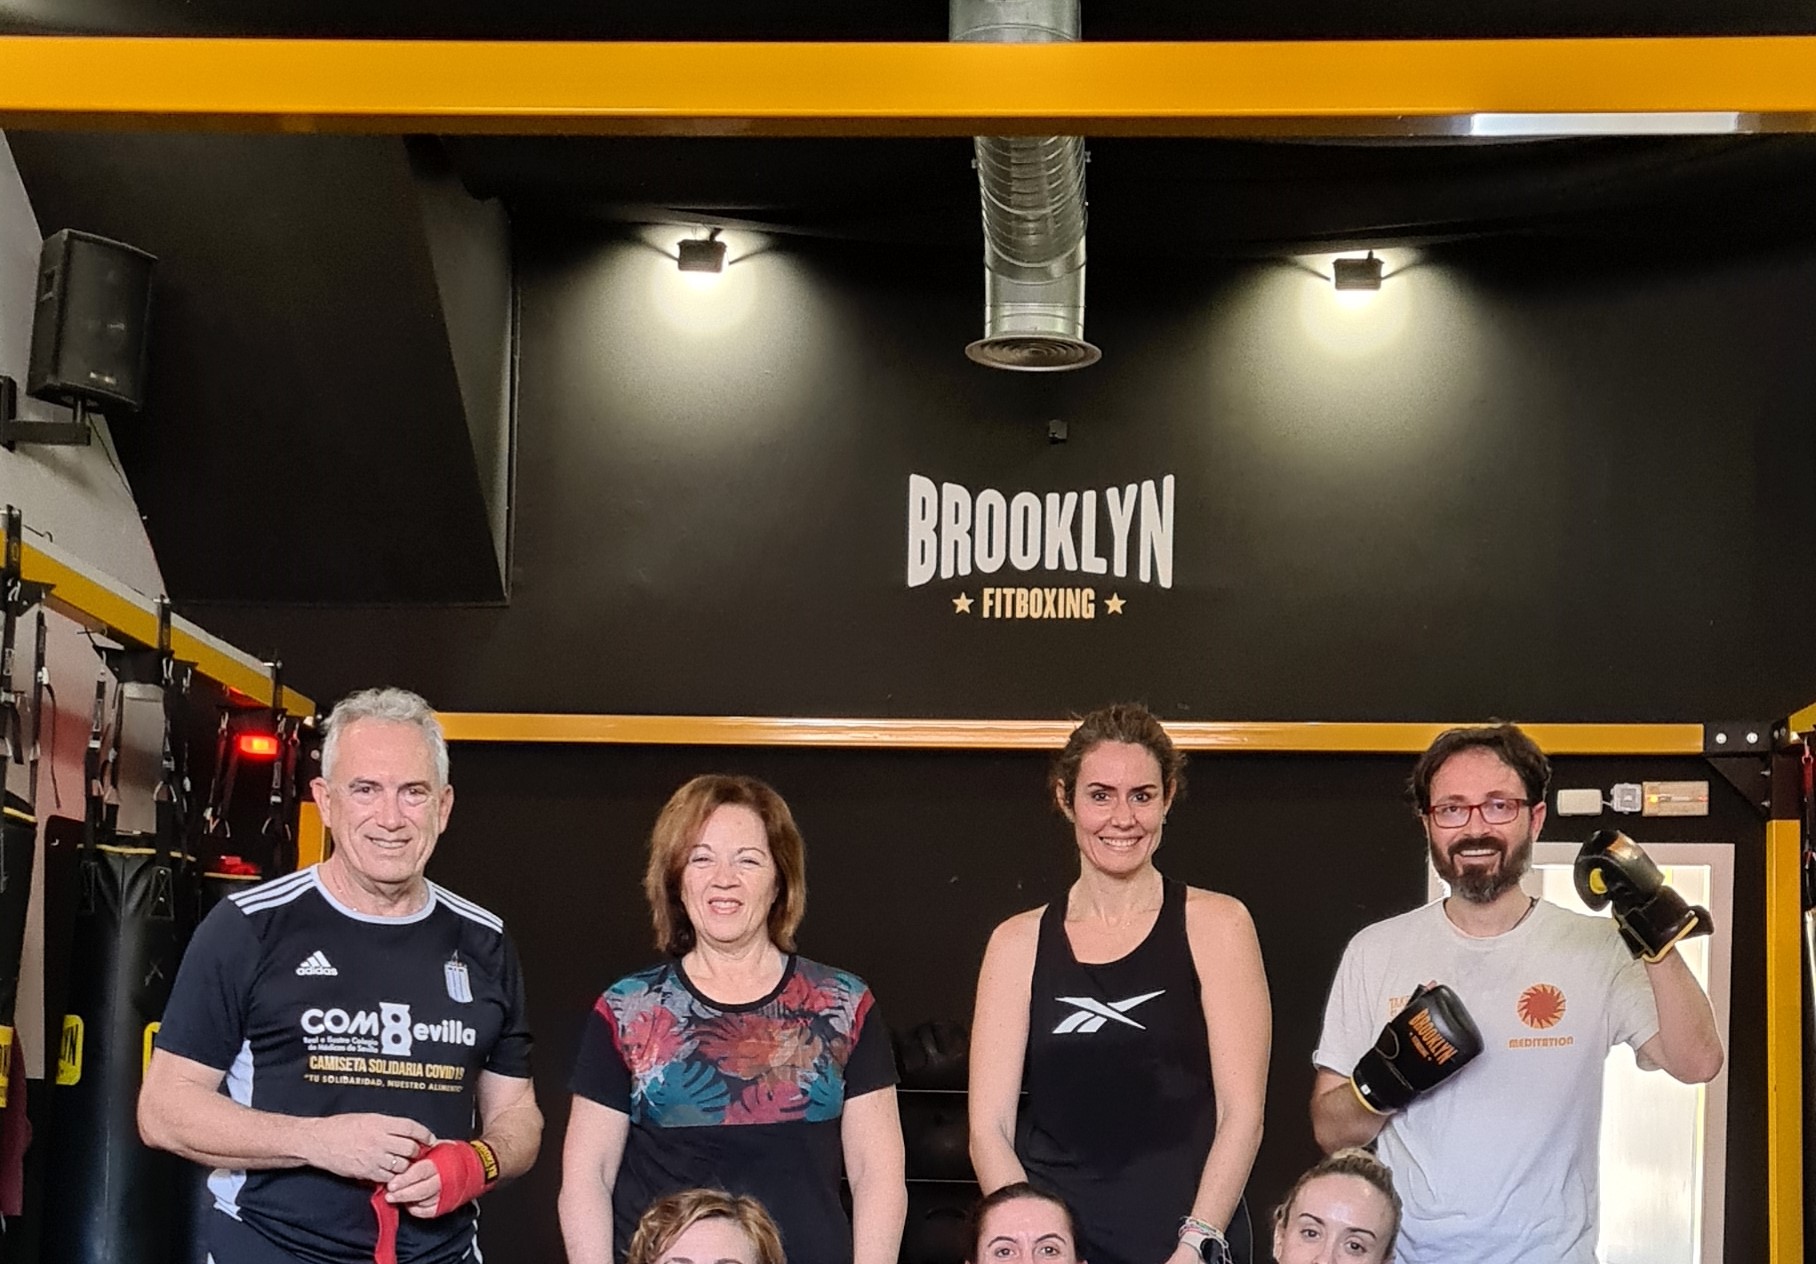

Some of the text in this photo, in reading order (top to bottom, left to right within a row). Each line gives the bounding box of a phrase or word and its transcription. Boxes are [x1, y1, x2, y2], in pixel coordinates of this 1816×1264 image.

[908, 473, 1175, 589] BROOKLYN
[982, 588, 1096, 619] FITBOXING
[296, 967, 339, 976] adidas
[1408, 1008, 1458, 1065] BROOKLYN
[309, 1055, 368, 1073] CAMISETA
[368, 1060, 424, 1078] SOLIDARIA
[387, 1080, 426, 1090] NUESTRO
